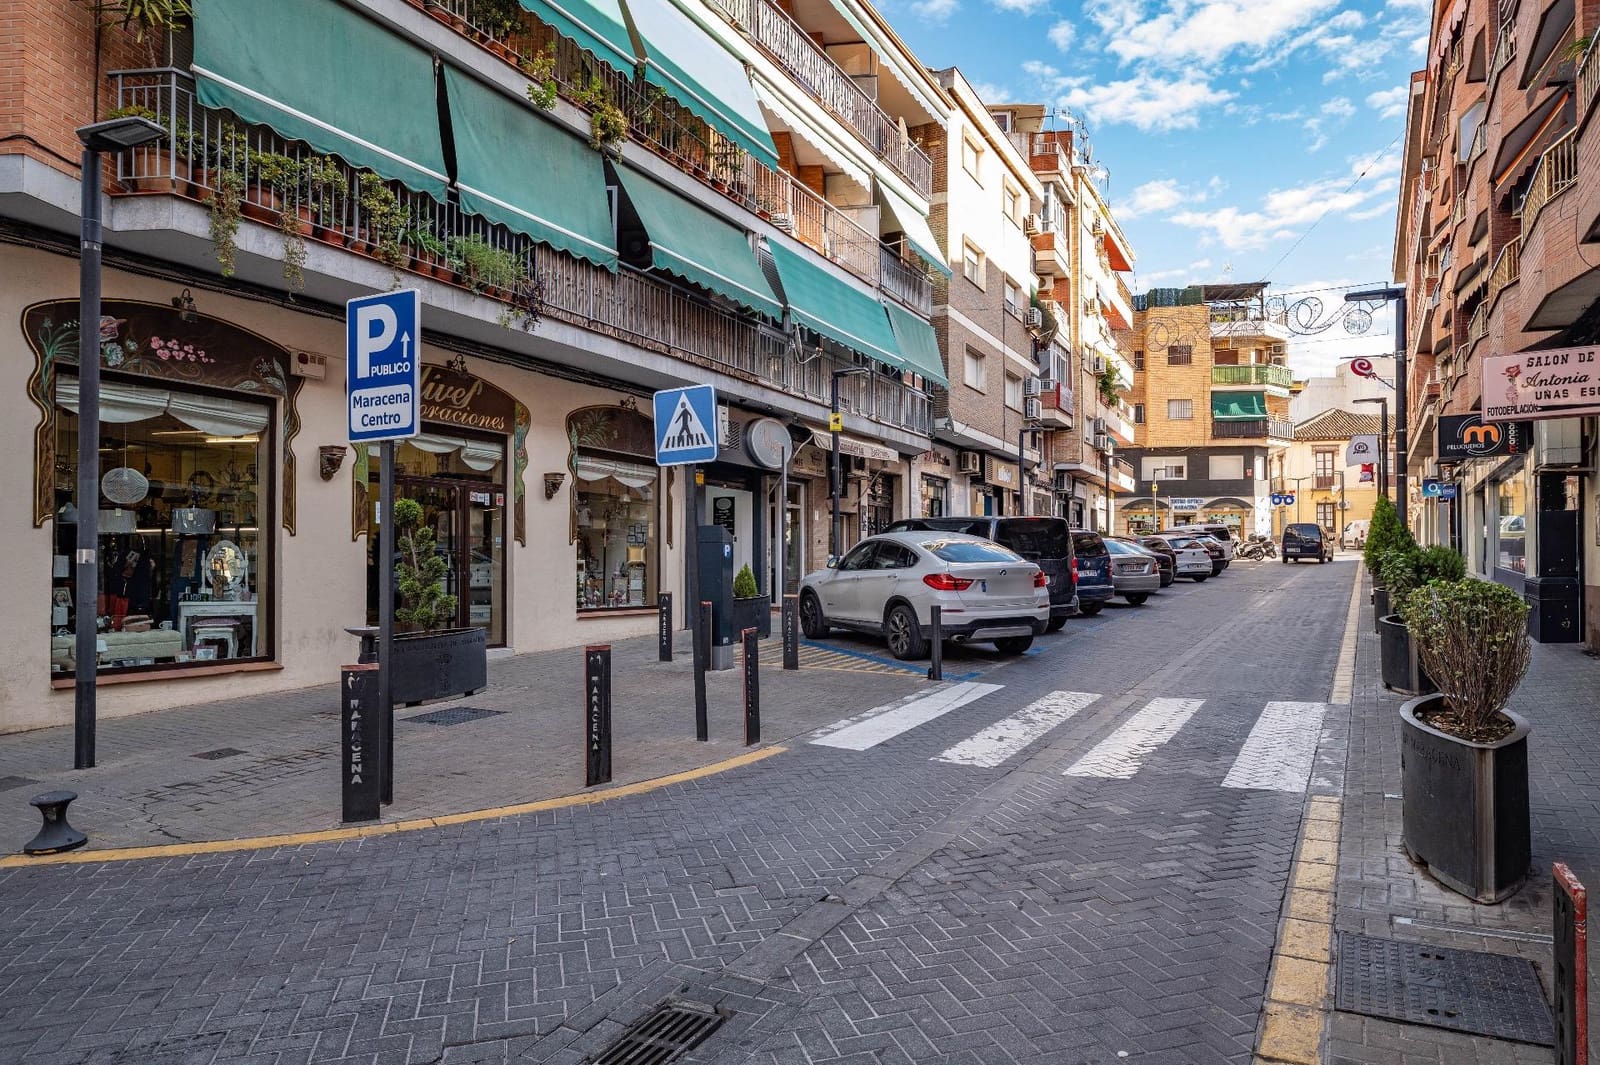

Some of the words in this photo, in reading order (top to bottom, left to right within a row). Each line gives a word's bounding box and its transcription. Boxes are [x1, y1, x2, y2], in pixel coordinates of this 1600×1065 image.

[357, 303, 398, 379] P
[1527, 354, 1569, 368] SALON
[1578, 352, 1595, 363] DE
[371, 361, 411, 377] PUBLICO
[1521, 371, 1590, 388] Antonia
[352, 392, 410, 409] Maracena
[361, 412, 401, 427] Centro
[420, 404, 505, 430] oraciones
[591, 676, 599, 750] MARACENA
